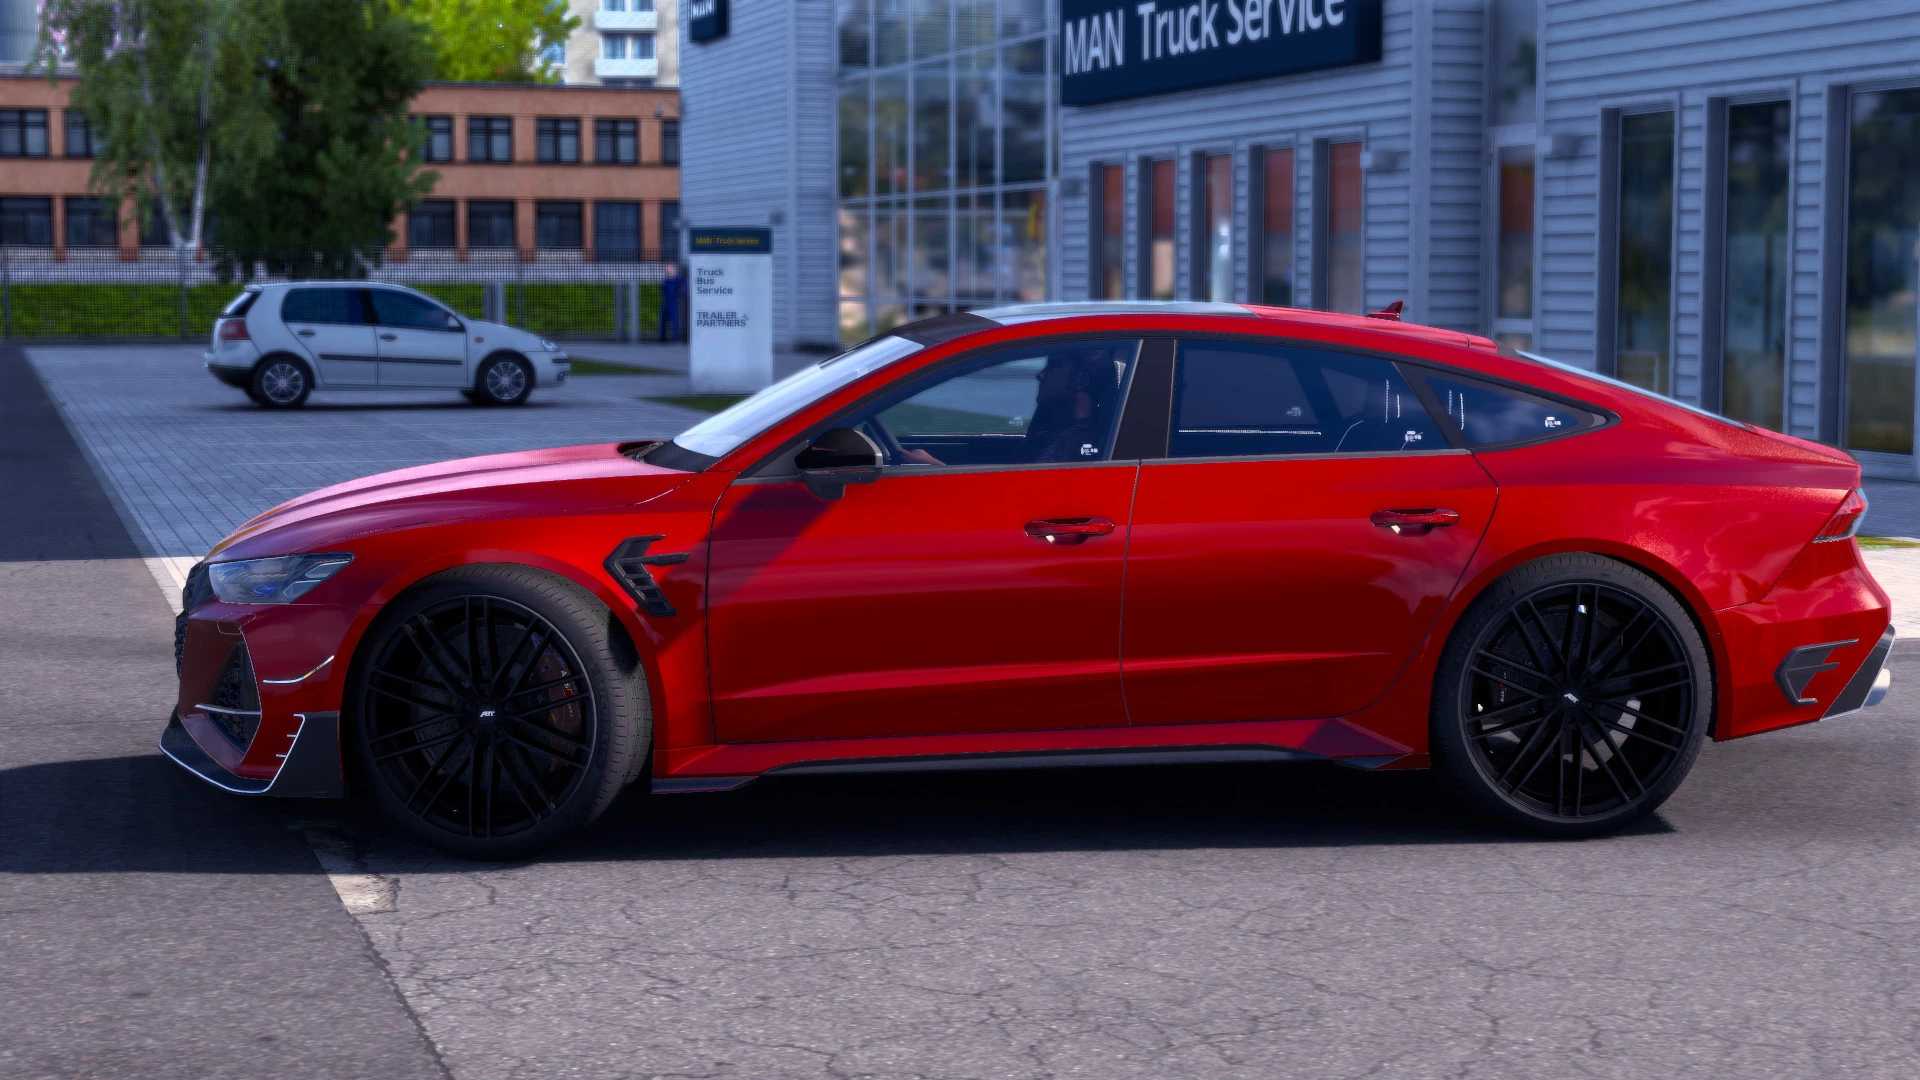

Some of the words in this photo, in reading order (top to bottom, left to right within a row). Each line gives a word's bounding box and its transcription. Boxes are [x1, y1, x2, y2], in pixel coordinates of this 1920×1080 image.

[1065, 9, 1125, 75] MAN
[1138, 0, 1219, 60] Truck
[1226, 0, 1345, 45] Service
[696, 268, 724, 276] Truck
[696, 277, 715, 285] Bus
[696, 286, 734, 295] Service
[696, 312, 737, 320] TRAILER
[696, 320, 747, 328] PARTNERS
